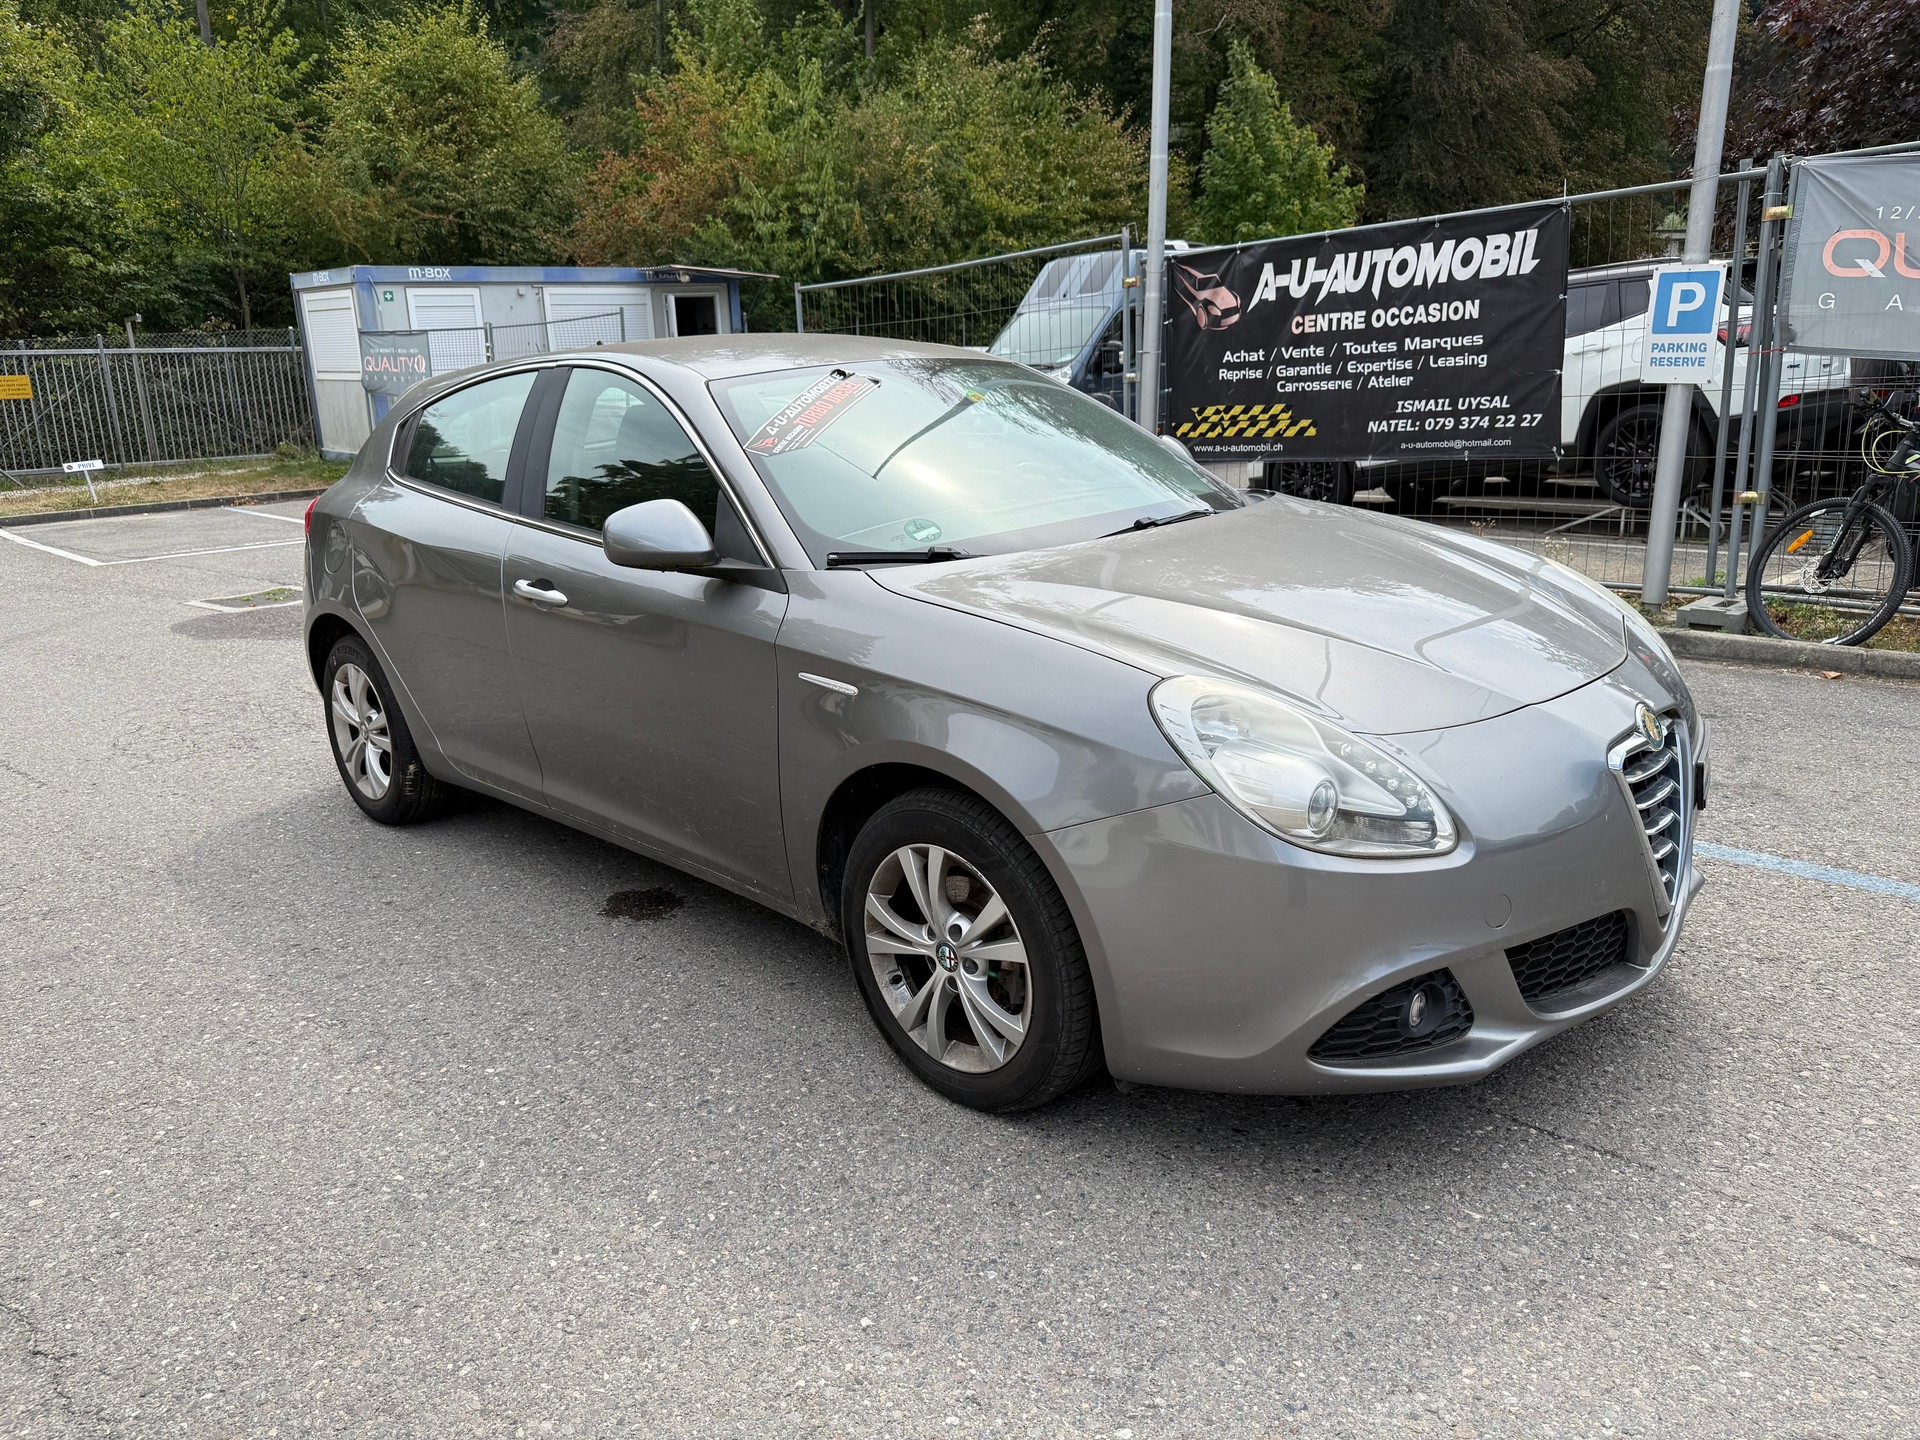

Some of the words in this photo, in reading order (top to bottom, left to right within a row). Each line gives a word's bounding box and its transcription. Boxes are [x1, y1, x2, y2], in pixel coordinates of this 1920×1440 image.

[1876, 205, 1920, 220] 12/
[1246, 228, 1541, 314] A-U-AUTOMOBIL
[1666, 282, 1706, 327] P
[1291, 310, 1366, 335] CENTRE
[1371, 299, 1480, 329] OCCASION
[1222, 348, 1265, 363] Achat
[1281, 345, 1325, 360] Vente
[1343, 340, 1398, 355] Toutes
[1404, 334, 1484, 351] Marques
[1651, 342, 1707, 353] PARKING
[1218, 367, 1263, 383] Reprise
[1275, 362, 1332, 378] Garantie
[1347, 358, 1413, 376] Expertise
[1429, 352, 1488, 368] Leasing
[1650, 356, 1706, 367] RESERVE
[1276, 379, 1353, 393] Carrosserie
[1367, 374, 1414, 389] Atelier
[793, 400, 834, 428] TURBO
[822, 380, 862, 404] DIESEL
[1395, 398, 1453, 413] ISMAIL
[1457, 395, 1511, 410] UYSAL
[1367, 419, 1420, 433] NATEL:
[1424, 416, 1455, 431] 079
[1458, 415, 1490, 430] 374
[1494, 414, 1516, 428] 22
[1520, 413, 1543, 427] 27
[1193, 443, 1284, 452] www.a-u-automobil.ch
[1400, 438, 1512, 449] a-u-automobil@hotmail.com
